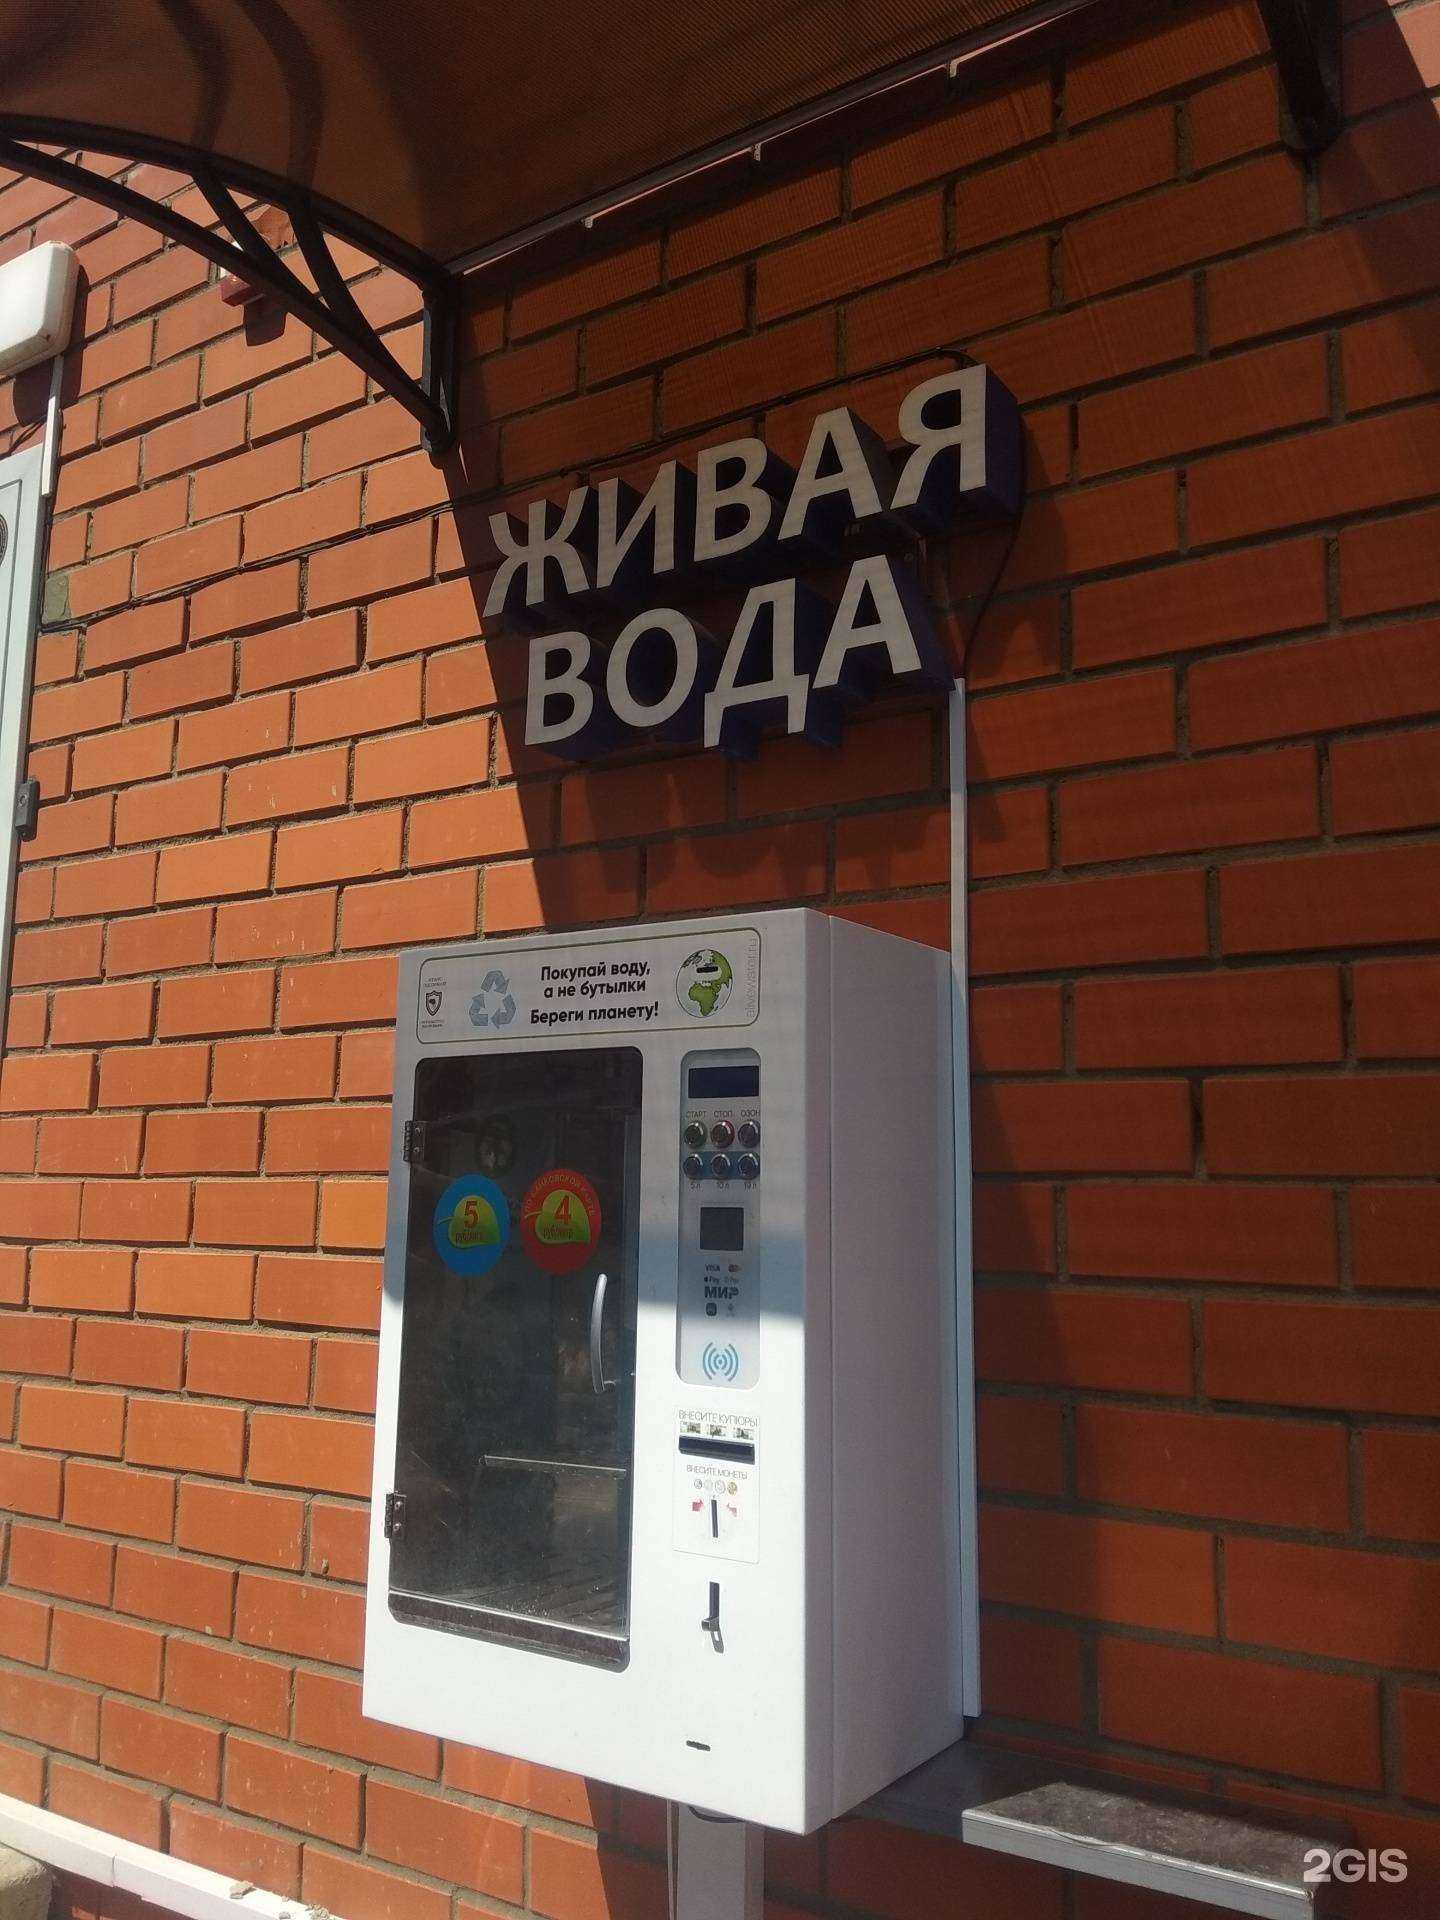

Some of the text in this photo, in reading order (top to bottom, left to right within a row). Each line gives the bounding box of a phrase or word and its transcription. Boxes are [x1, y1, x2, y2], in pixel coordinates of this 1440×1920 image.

[482, 364, 987, 618] ЖИВАЯ
[525, 555, 922, 749] ВОДА
[541, 961, 650, 982] Покупай воду,
[544, 980, 646, 999] а не бутылки
[531, 1001, 659, 1026] Береги планету!
[686, 1110, 707, 1119] СТАРТ
[714, 1110, 733, 1118] СТОП
[741, 1109, 760, 1117] ОЗОН
[464, 1200, 480, 1228] 5
[554, 1195, 572, 1224] 4
[704, 1286, 739, 1299] МИР
[679, 1411, 758, 1427] ВНЕСИТЕ КУПЮРЫ
[686, 1465, 717, 1476] ВНЕСИТЕ
